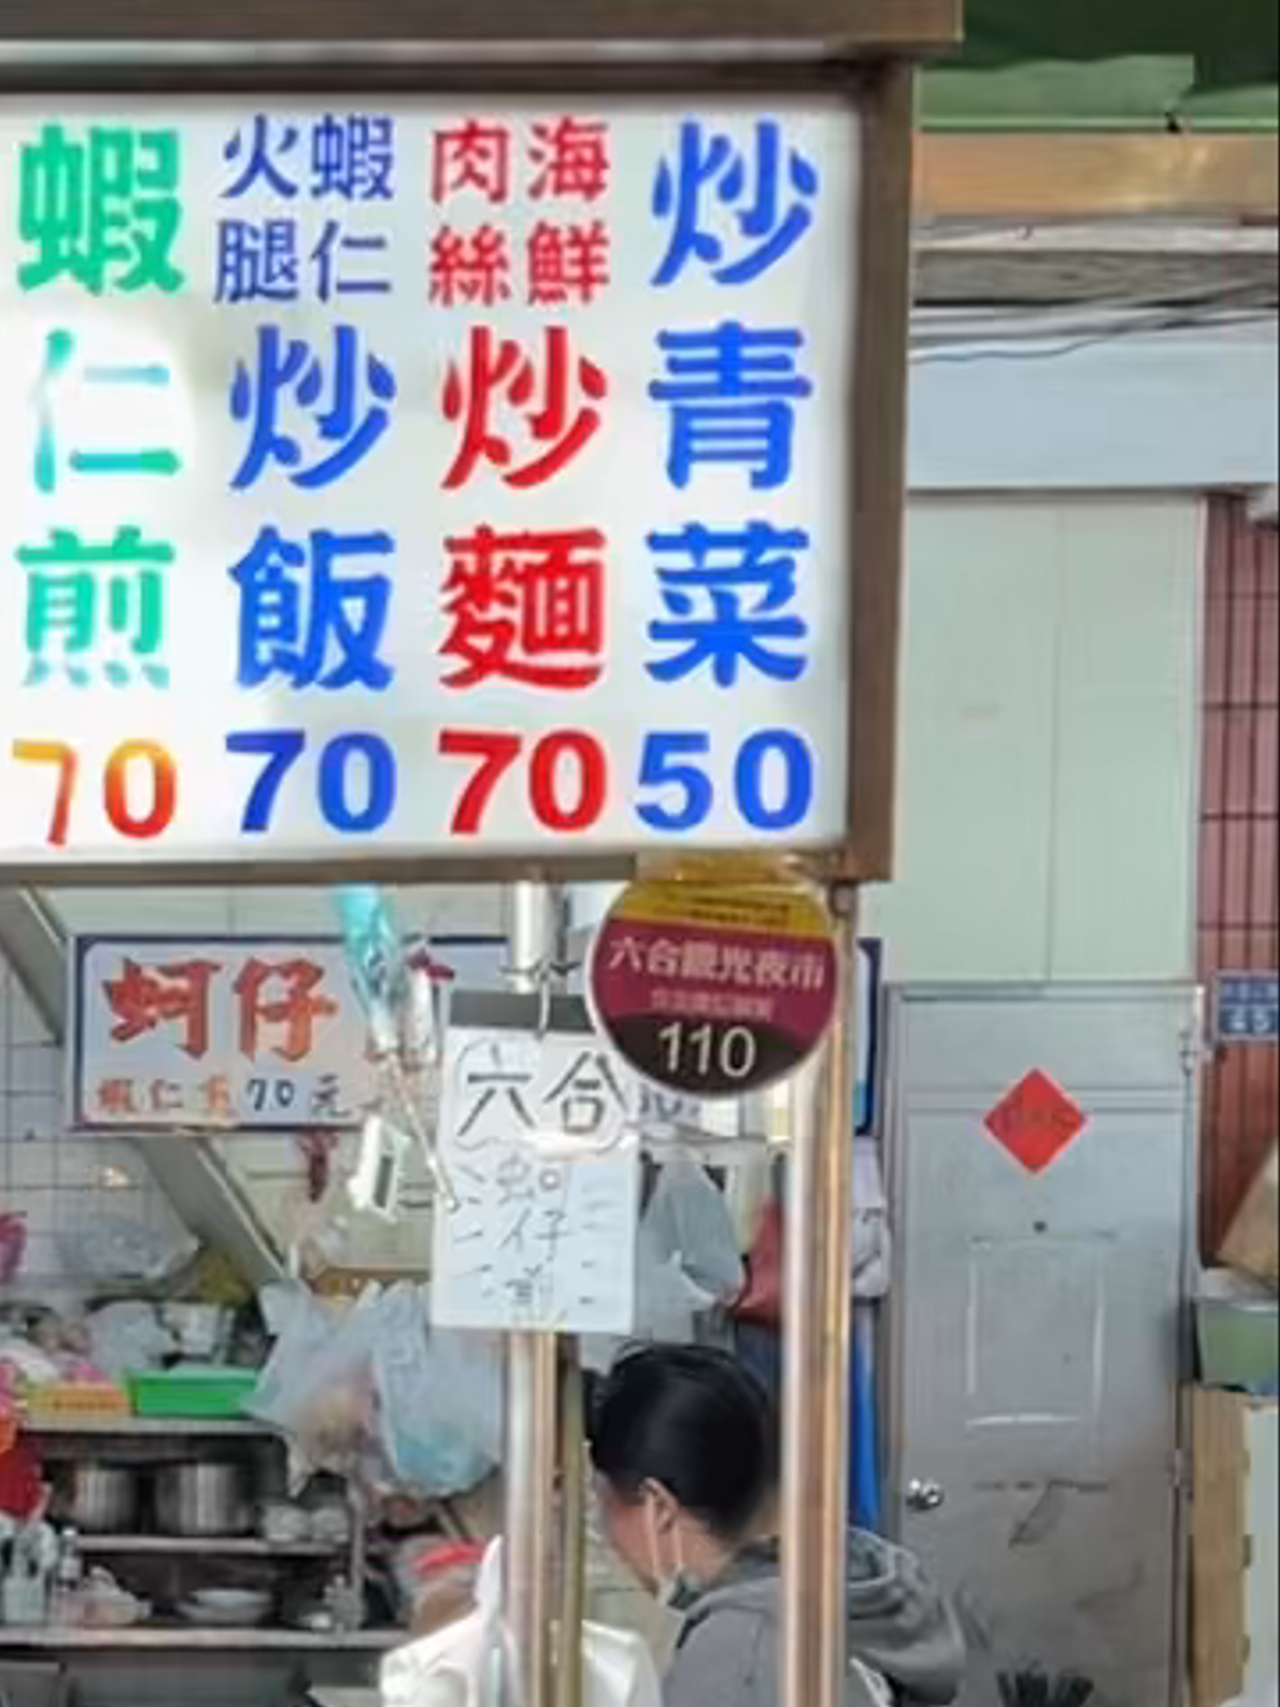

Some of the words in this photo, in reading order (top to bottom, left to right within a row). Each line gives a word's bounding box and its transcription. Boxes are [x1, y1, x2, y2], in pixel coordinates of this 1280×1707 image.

[14, 120, 190, 691] 蝦仁煎
[644, 113, 823, 690] 炒青菜
[226, 323, 398, 693] 炒飯
[438, 323, 610, 693] 炒麵
[11, 738, 179, 848] 70
[226, 728, 398, 837] 70
[438, 729, 609, 838] 70
[636, 729, 817, 836] 50
[457, 1042, 627, 1137] 六合
[658, 1021, 756, 1078] 110
